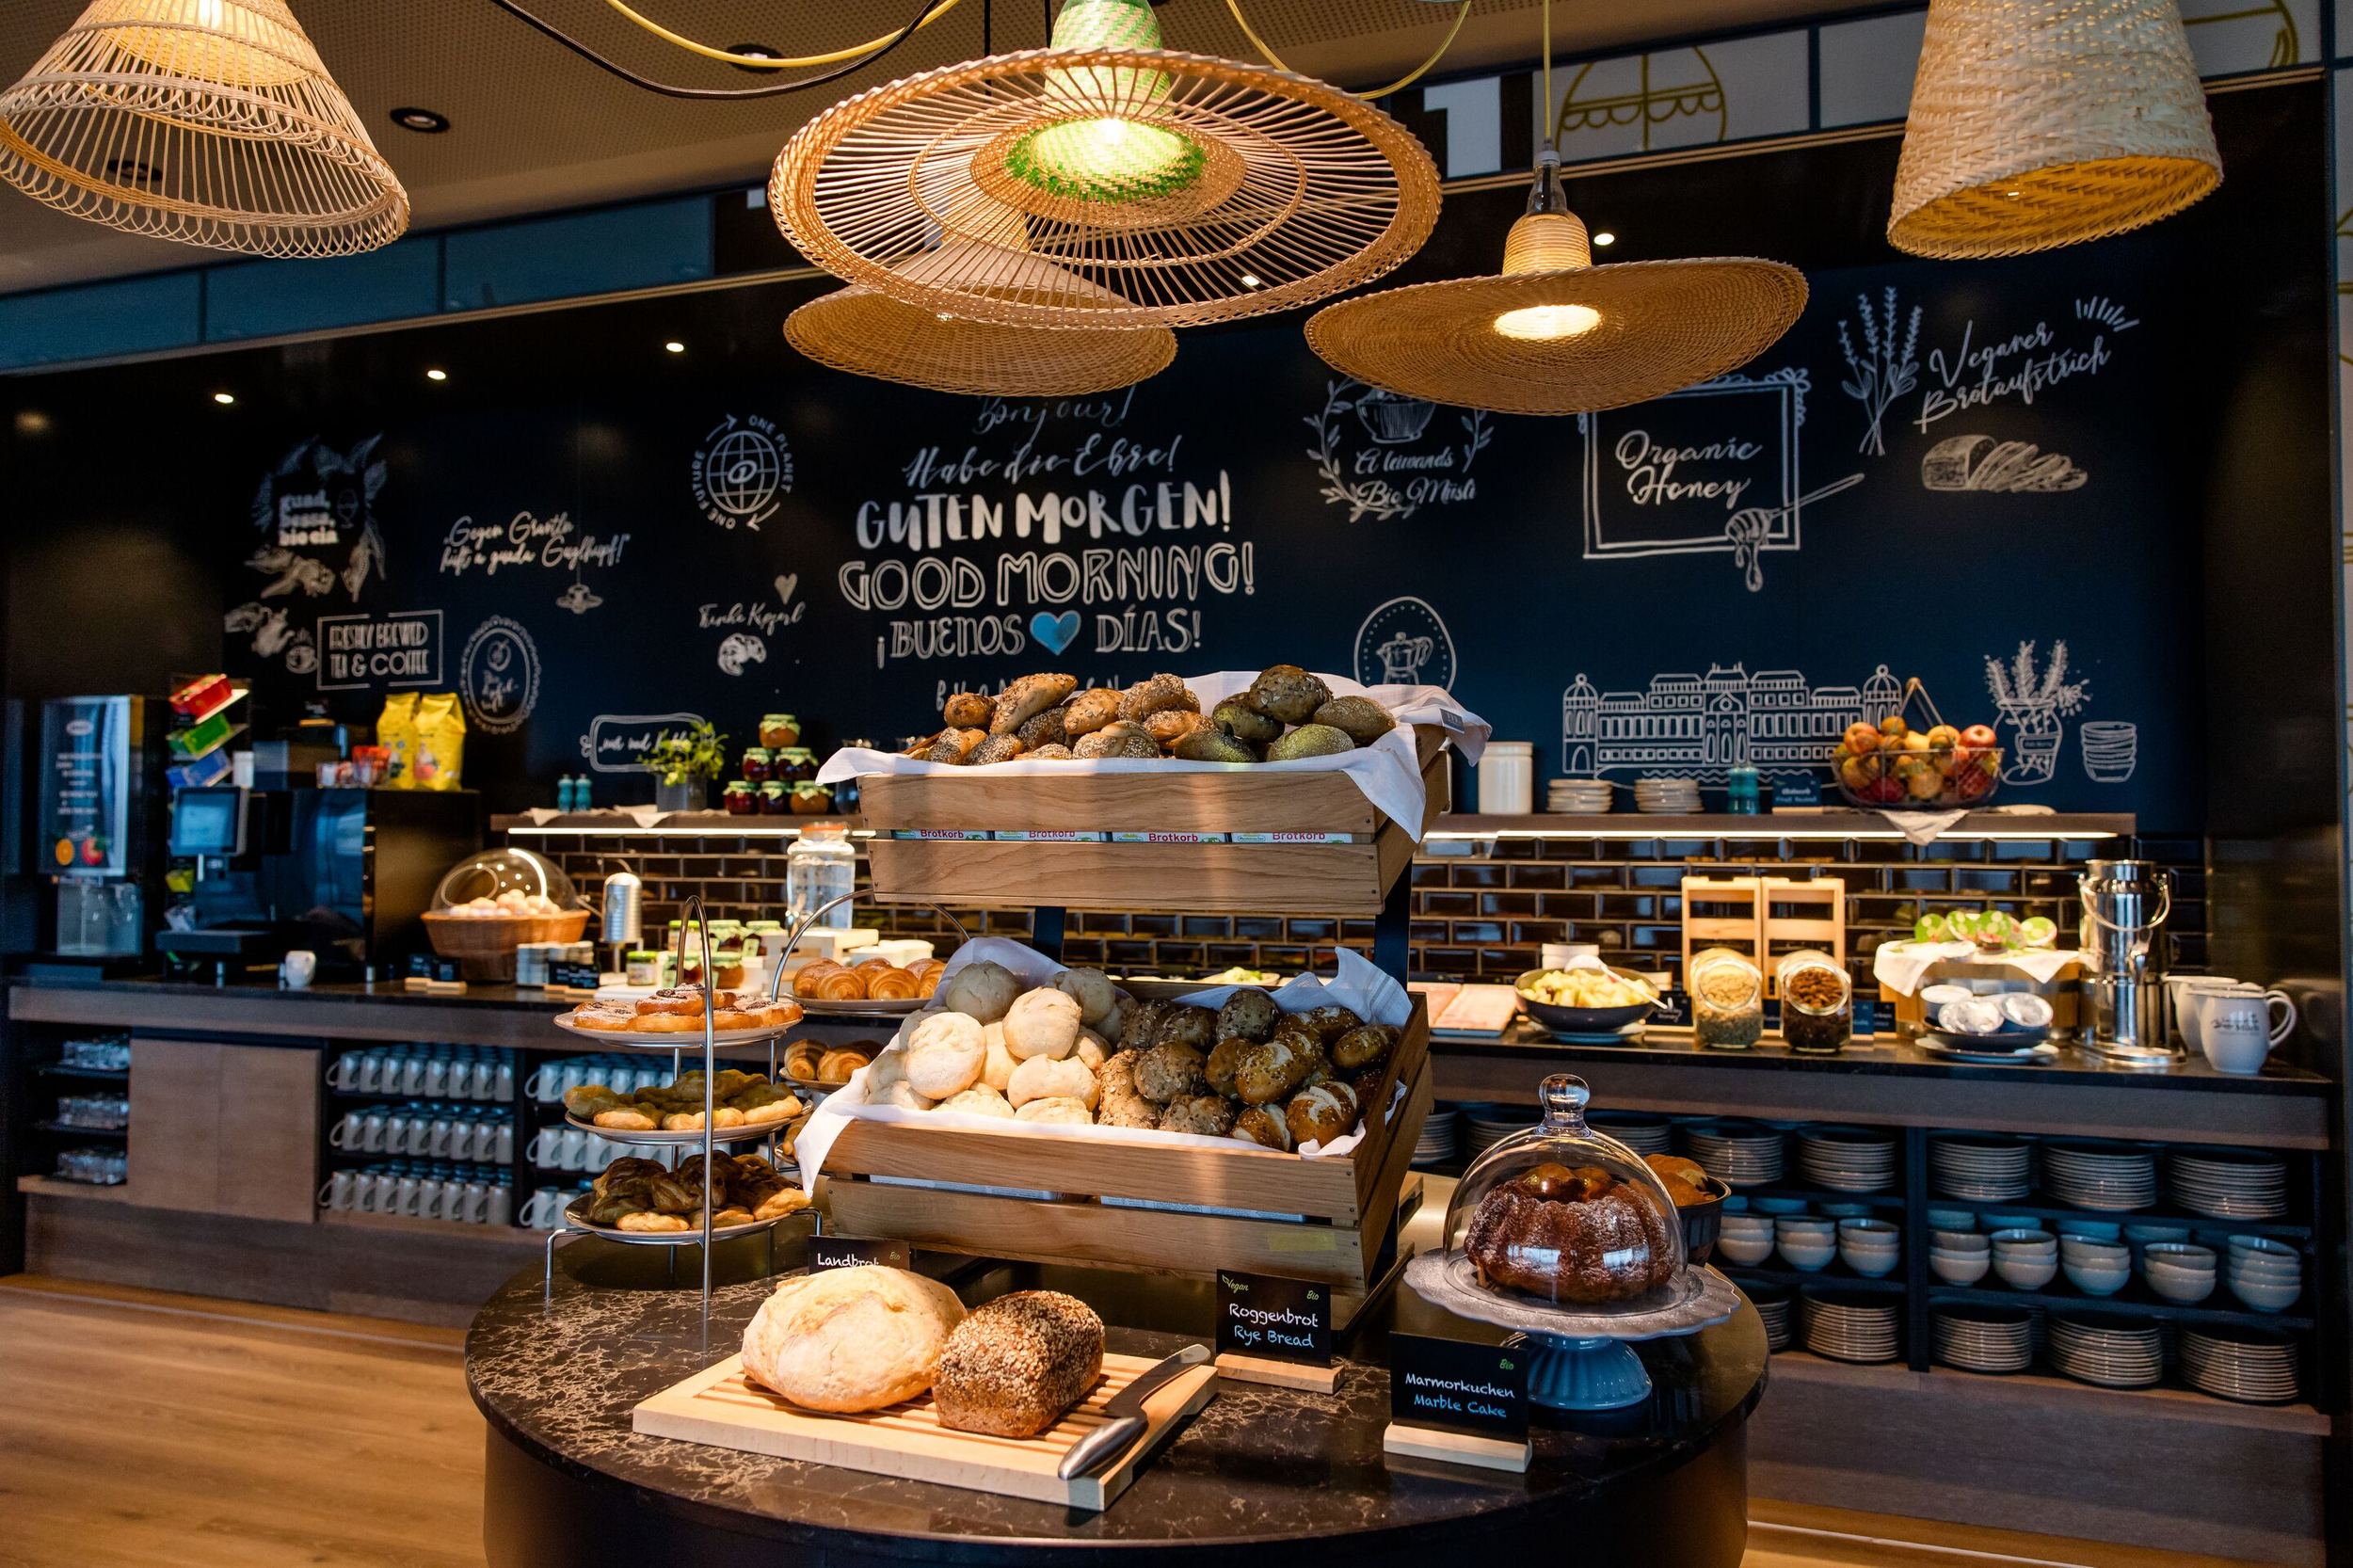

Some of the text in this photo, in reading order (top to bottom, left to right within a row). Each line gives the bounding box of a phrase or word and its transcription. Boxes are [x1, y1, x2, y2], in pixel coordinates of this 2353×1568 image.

[1929, 320, 2055, 387] Veganer
[1913, 335, 2113, 435] Brotaufstrich
[747, 414, 794, 494] ONE PLANET
[903, 433, 1182, 488] Habe die Ehre!
[1615, 428, 1764, 472] Organic
[692, 450, 737, 530] ONE FUTURE
[1356, 475, 1476, 507] Bio Müsli
[1627, 464, 1752, 510] Honey
[856, 470, 1231, 551] GUTEN MORGEN!
[839, 541, 1255, 610] GOOD MORNING!
[1096, 604, 1201, 653] DÍAS!
[351, 653, 367, 678] &
[370, 649, 429, 676] COFFEE
[920, 829, 964, 839] Brotkorb
[1148, 833, 1198, 842] Brotkorb
[1273, 832, 1325, 840] Brotkorb
[888, 1251, 901, 1261] Bio
[1223, 1275, 1319, 1301] Vegan Bio
[1229, 1303, 1319, 1327] Roggenbrot
[1234, 1325, 1315, 1348] Rye Bread
[1499, 1358, 1514, 1370] Bio
[1405, 1373, 1515, 1399] Marmorkuchen
[1414, 1394, 1507, 1417] Marble Cake
